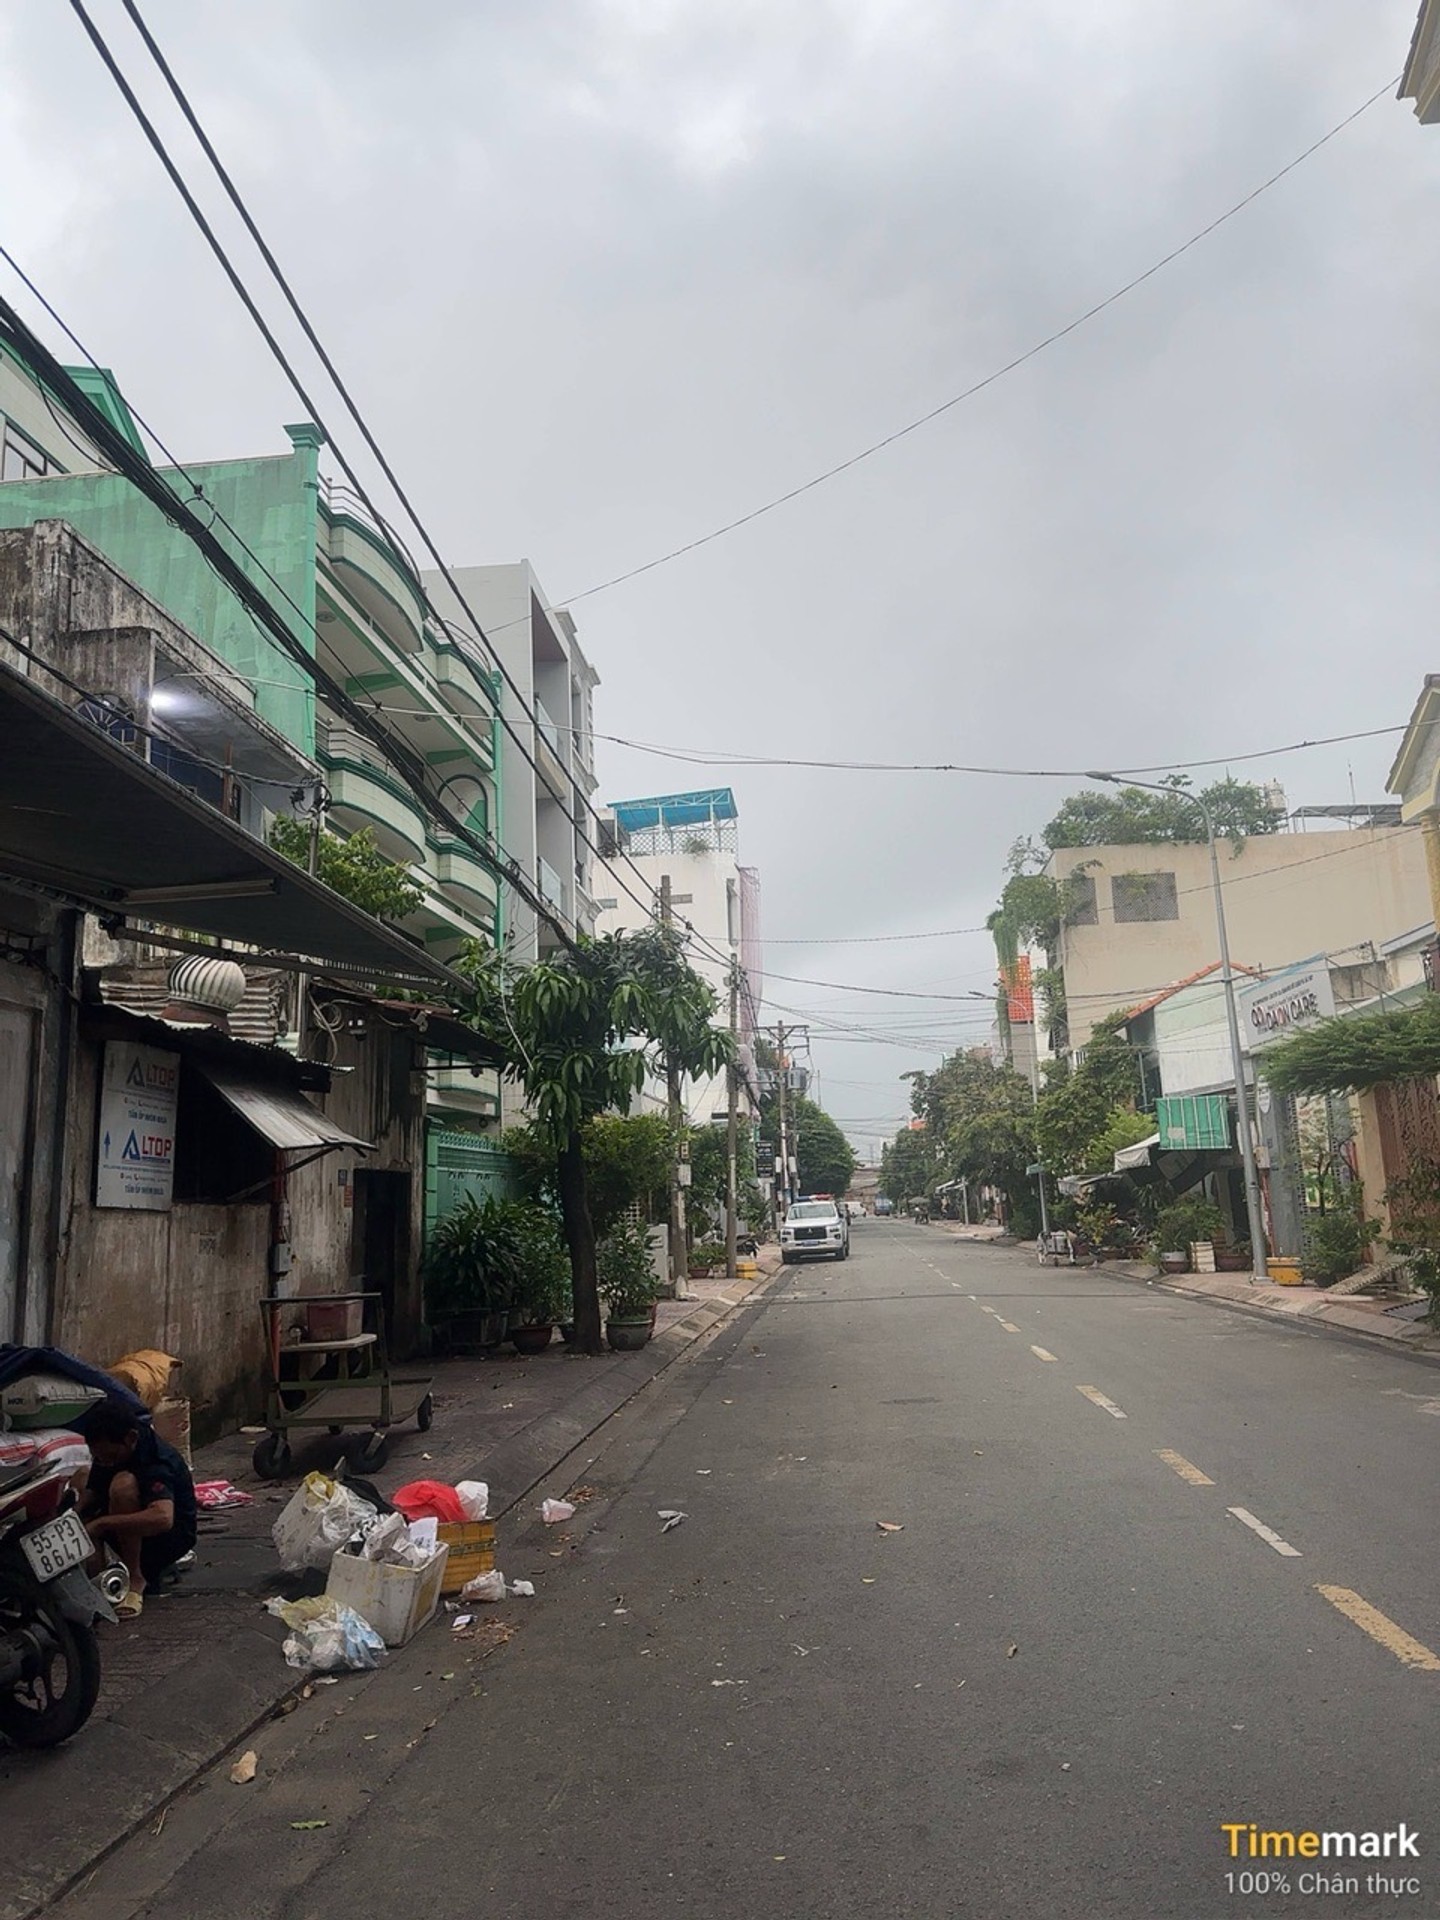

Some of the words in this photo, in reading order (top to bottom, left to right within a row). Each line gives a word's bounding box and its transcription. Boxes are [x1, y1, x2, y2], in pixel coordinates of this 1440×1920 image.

[126, 1056, 175, 1088] ALTOP
[122, 1128, 172, 1160] ALTOP
[31, 1520, 76, 1554] 55-P3
[40, 1538, 83, 1574] 8647
